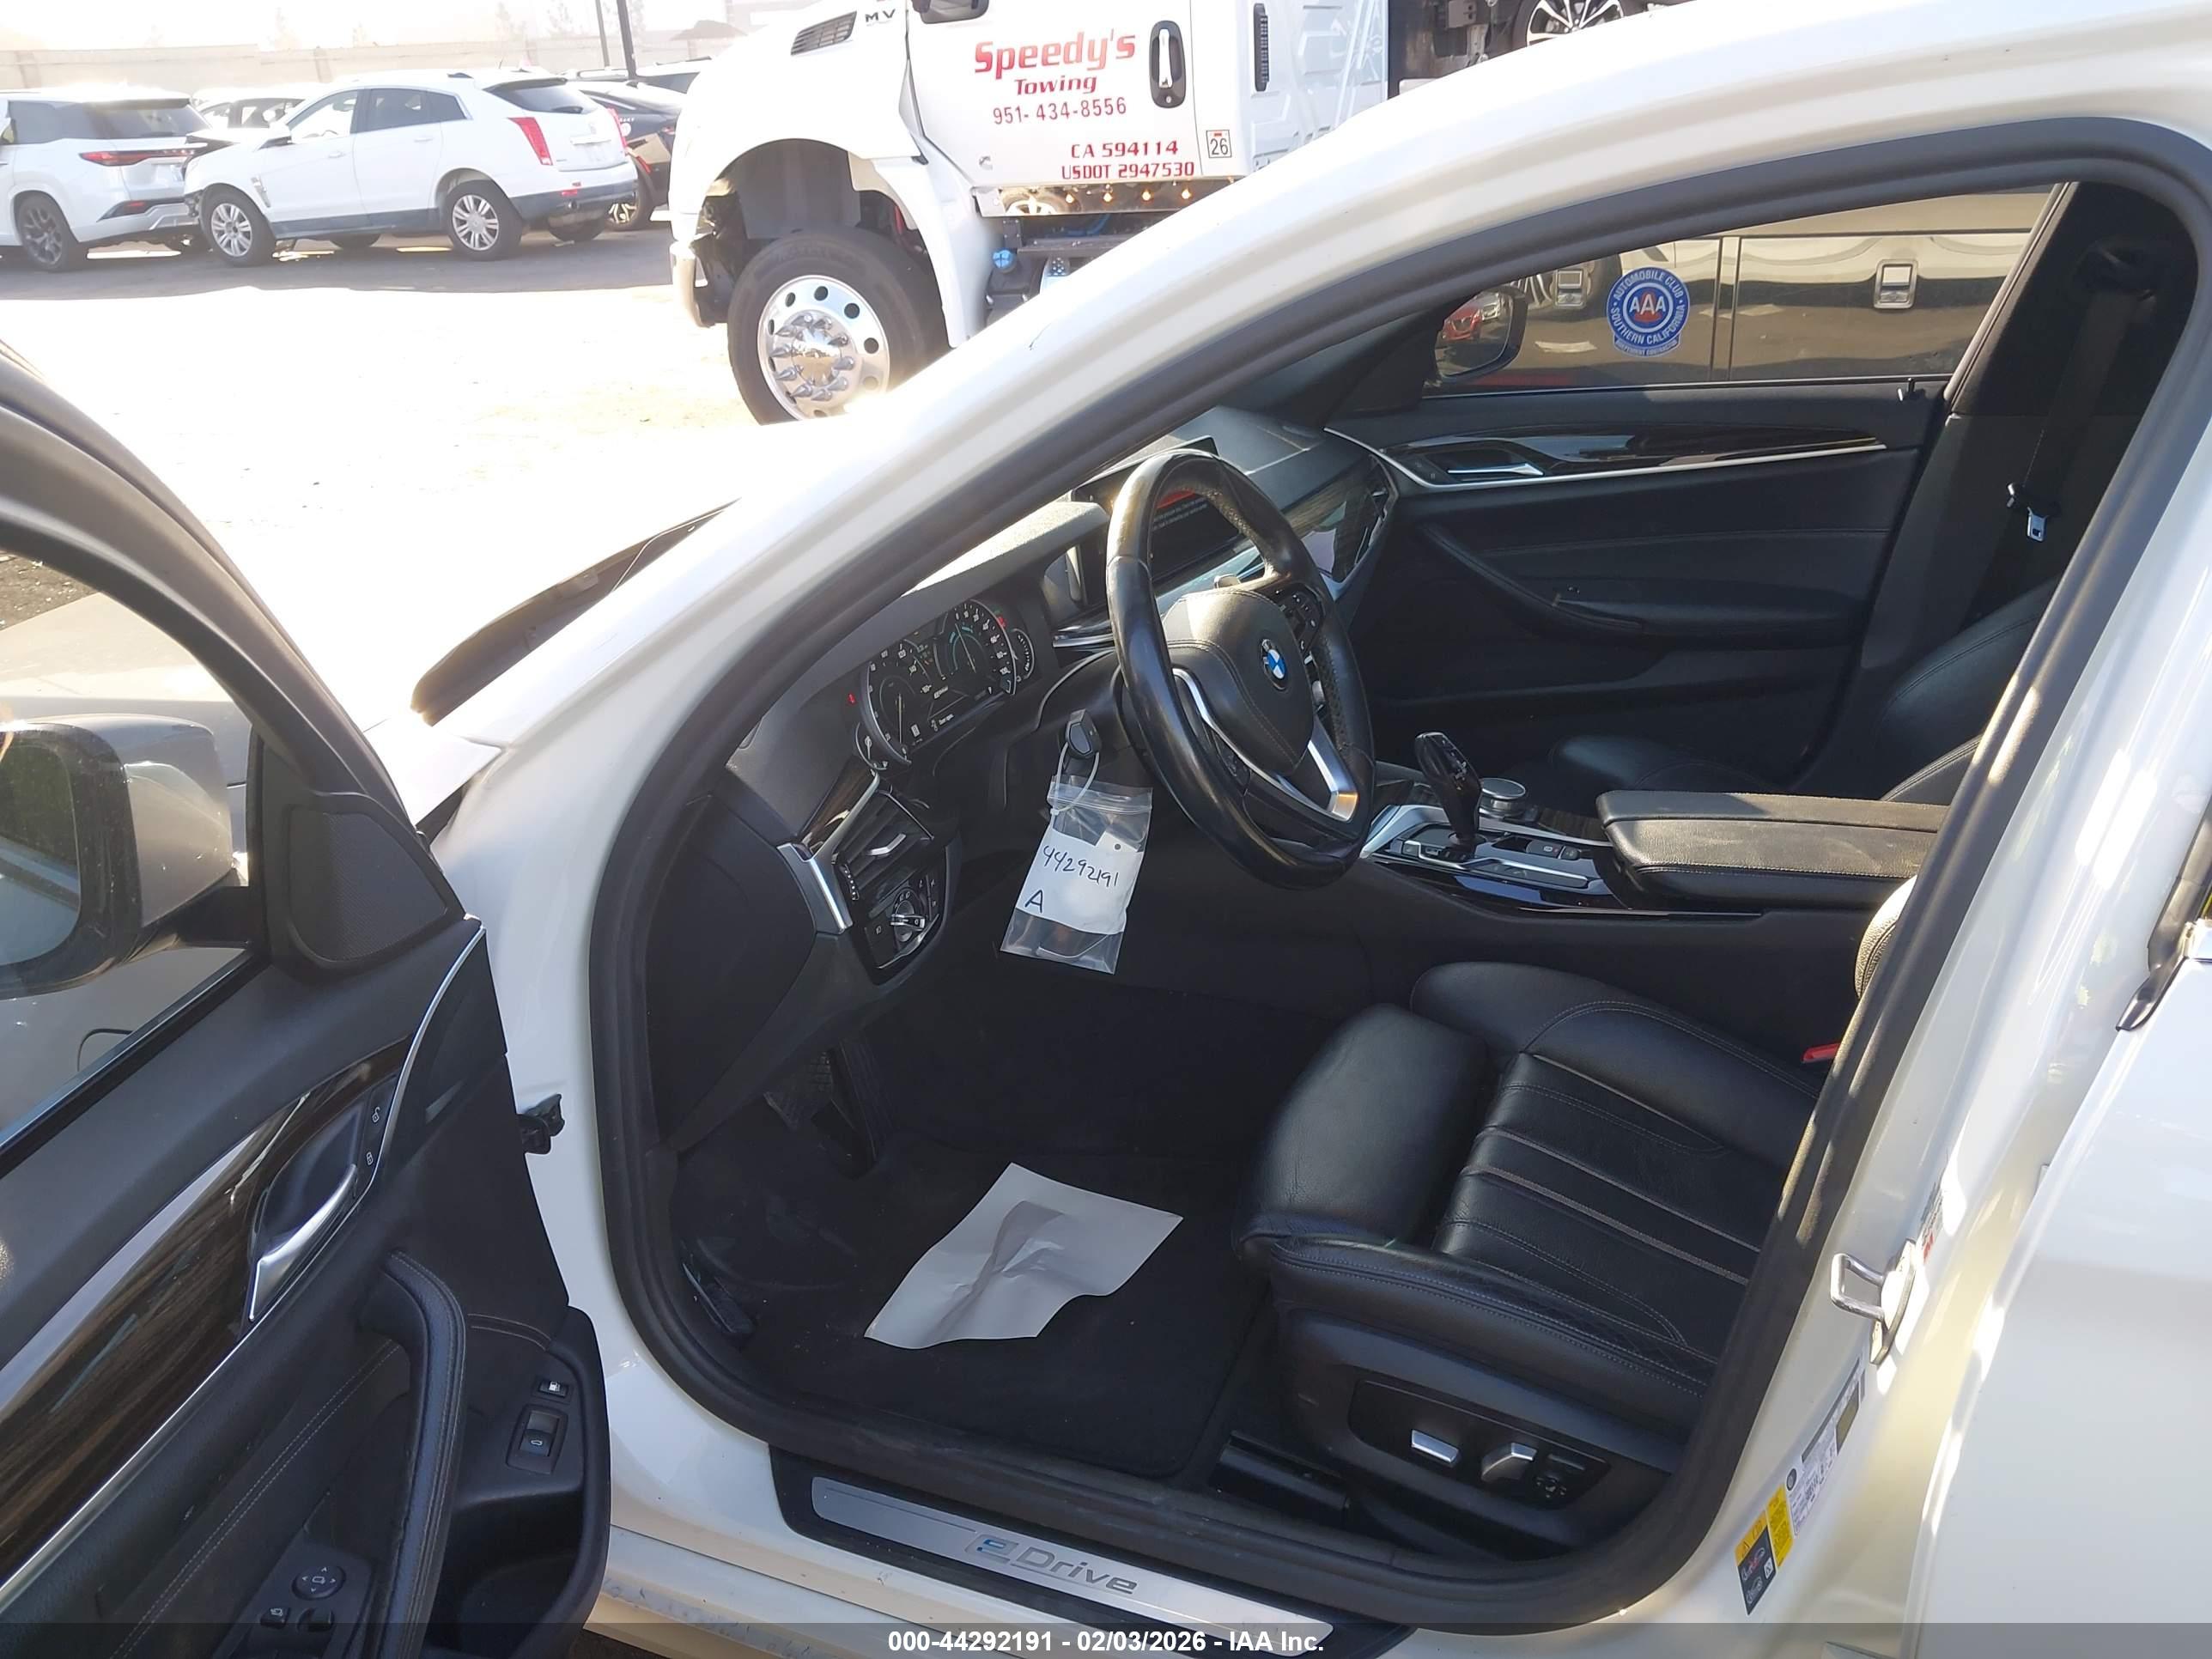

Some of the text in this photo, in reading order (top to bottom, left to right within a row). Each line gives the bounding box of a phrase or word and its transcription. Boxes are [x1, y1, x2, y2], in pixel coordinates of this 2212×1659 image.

[974, 28, 1137, 80] Speedy's
[1014, 74, 1097, 96] Towing
[1071, 139, 1179, 159] CA 594114
[1210, 137, 1229, 155] 26
[1061, 161, 1195, 180] USDOT 2947530
[1613, 270, 1684, 301] AUTOMOBILE CLUB
[1629, 294, 1666, 315] AAA
[1610, 304, 1686, 344] SOUTHERN CALIFORNIA
[1043, 845, 1119, 887] 44292191
[1024, 889, 1044, 913] A
